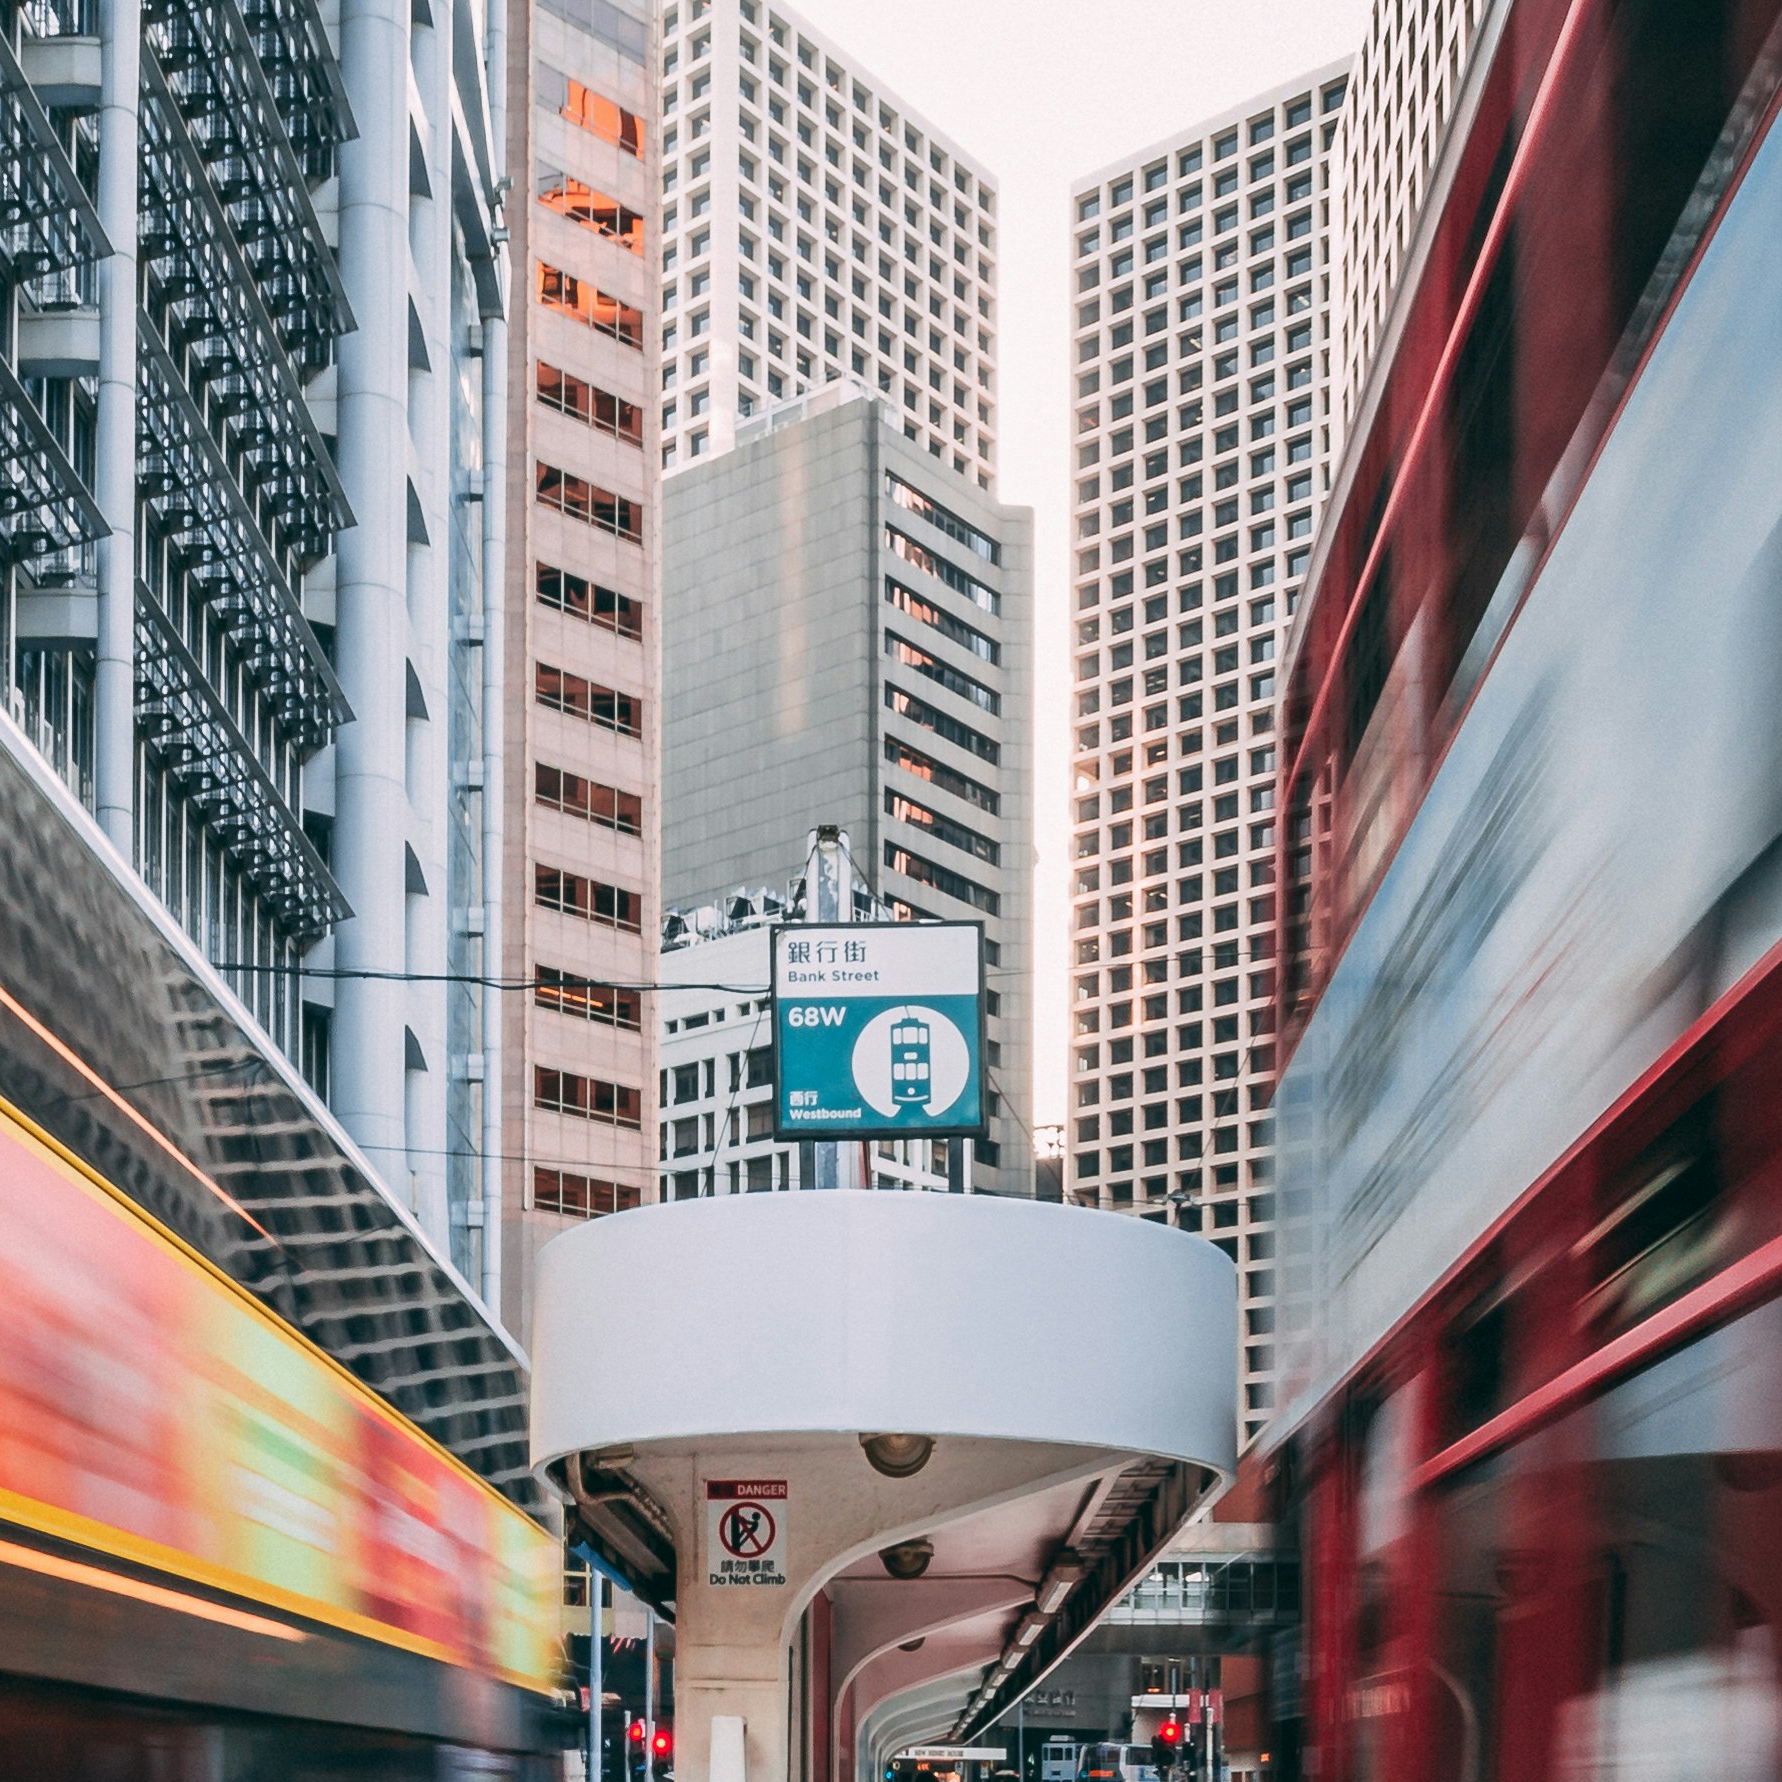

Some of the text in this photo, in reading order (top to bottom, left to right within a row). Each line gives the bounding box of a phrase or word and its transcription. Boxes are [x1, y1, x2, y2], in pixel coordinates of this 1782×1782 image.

[788, 941, 866, 963] 銀行街
[788, 970, 879, 982] Bank Street
[788, 1006, 847, 1027] 68W
[789, 1090, 818, 1106] 西行
[789, 1108, 862, 1120] Westbound
[737, 1484, 786, 1496] DANGER
[710, 1573, 786, 1585] Do Not Climb
